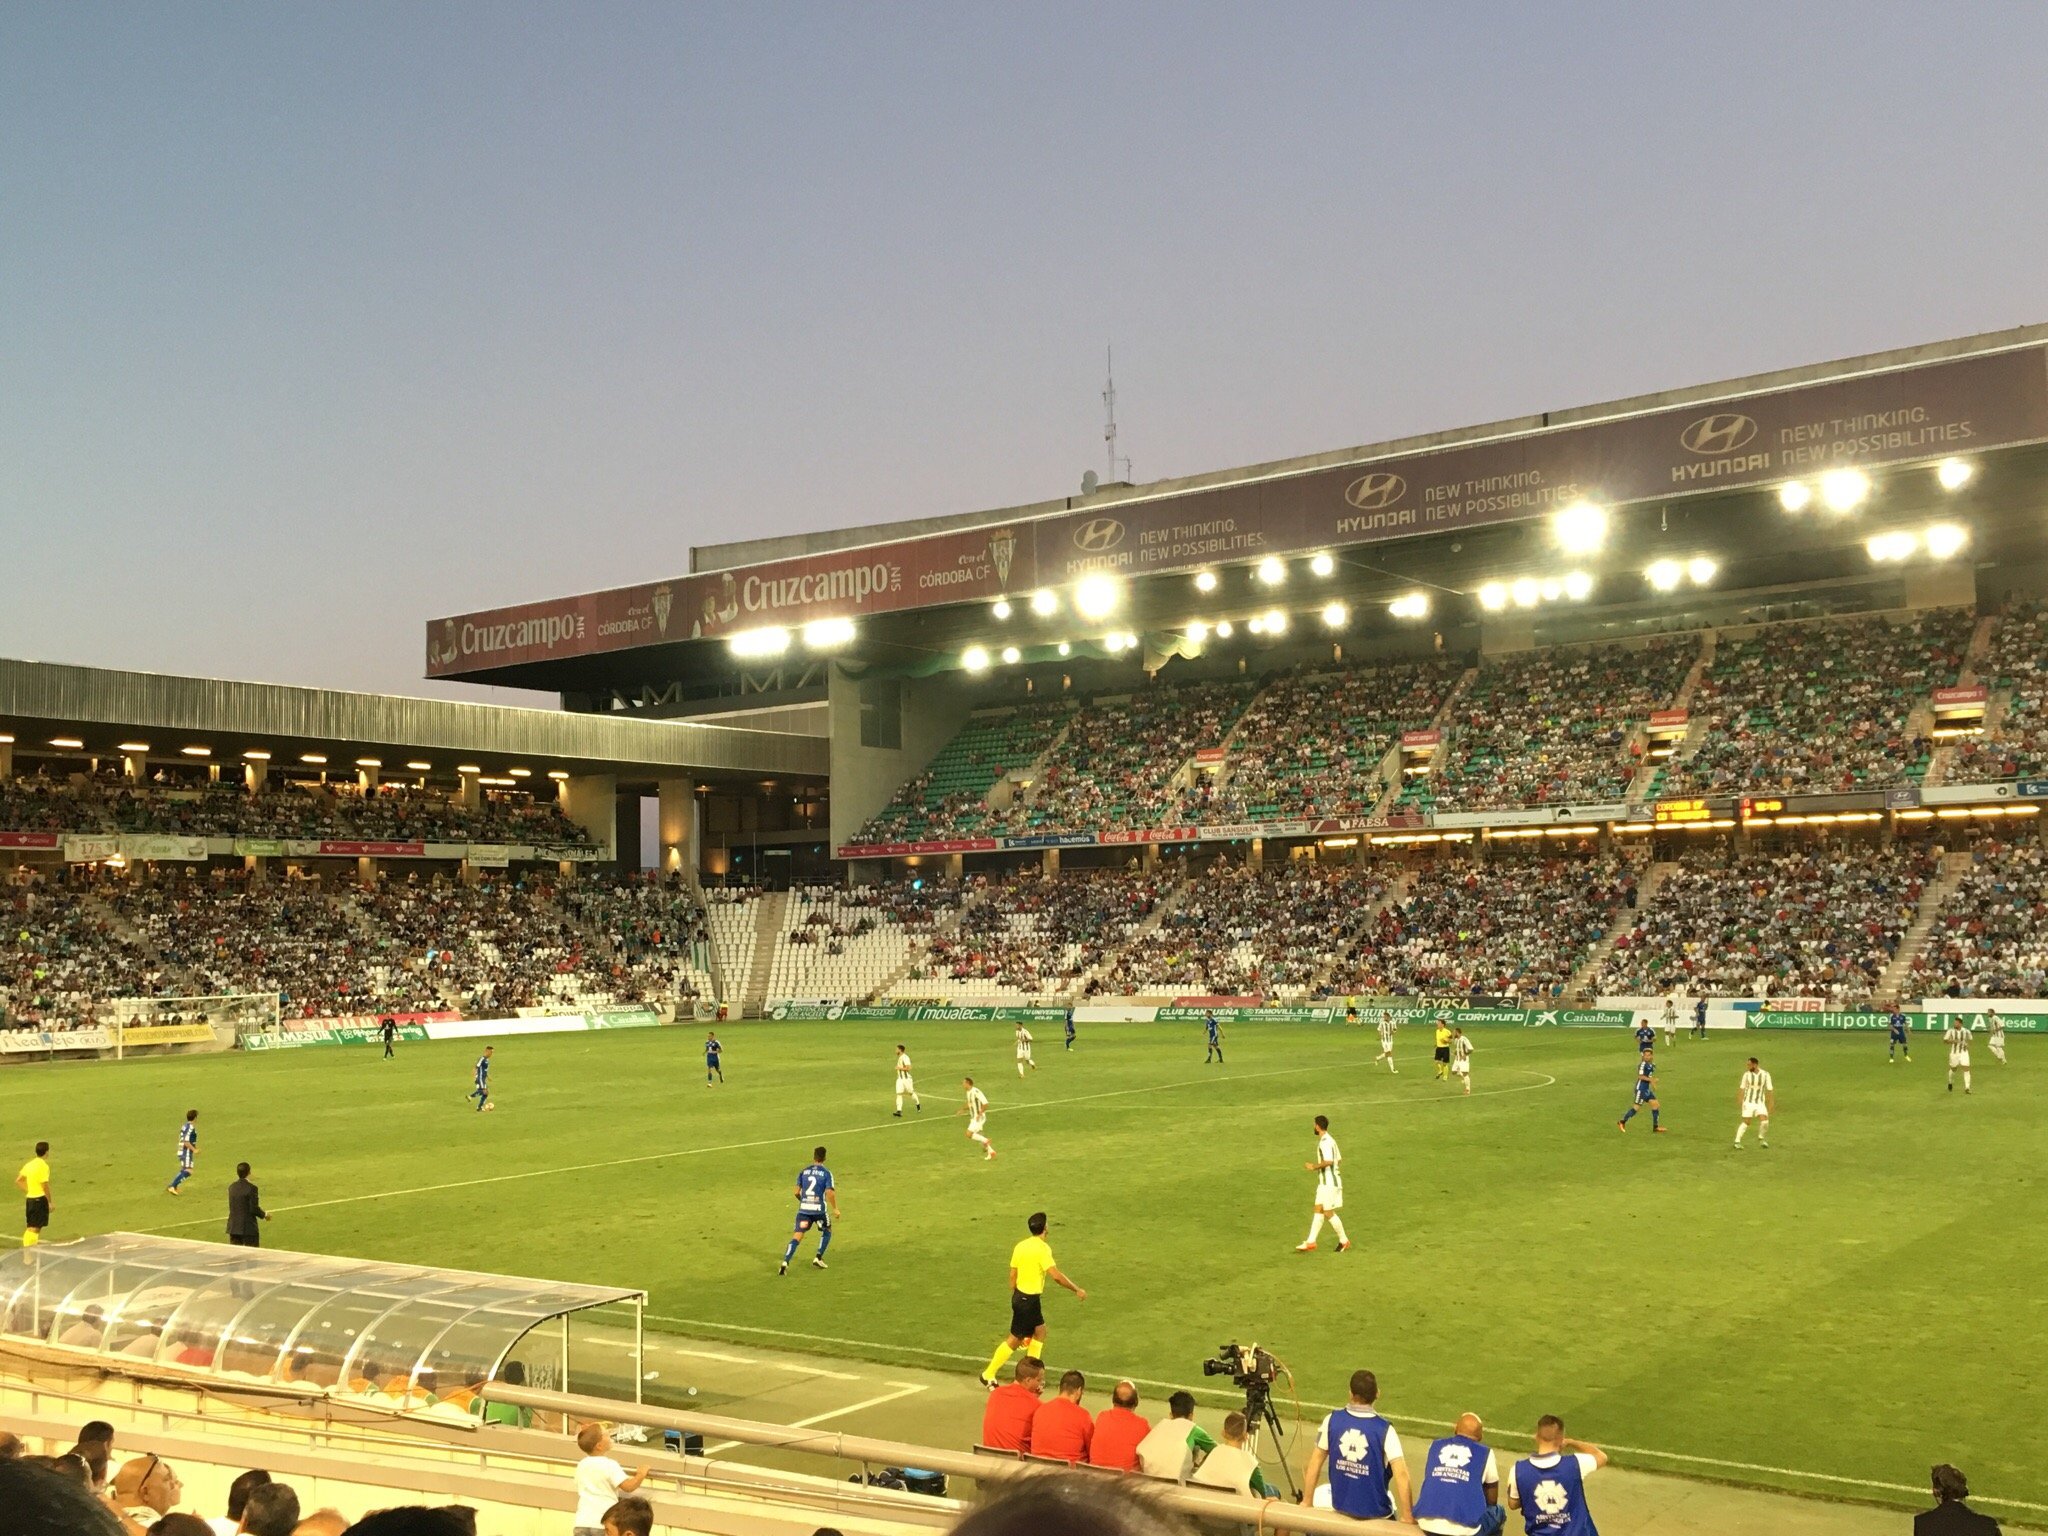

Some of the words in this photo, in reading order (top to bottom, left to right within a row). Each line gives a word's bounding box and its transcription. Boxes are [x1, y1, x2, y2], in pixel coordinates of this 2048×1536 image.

[1781, 422, 1825, 444] NEW
[1830, 406, 1930, 436] THINKING.
[1781, 444, 1827, 466] NEW
[1671, 453, 1770, 482] HYUNDAI
[1425, 482, 1460, 502] NEW
[1465, 470, 1545, 496] THINKING.
[1337, 509, 1416, 534] HYUNDAI
[1425, 502, 1461, 521] NEW
[1140, 528, 1169, 545] NEW
[1066, 551, 1133, 574] HYUNDAI
[1140, 545, 1169, 562] NEW
[890, 566, 902, 592] SIN
[919, 569, 974, 589] CÓRDOBA
[975, 565, 991, 580] CF
[743, 563, 888, 612] Cruzcampo
[461, 613, 574, 655] Cruzcampo
[576, 616, 585, 639] SIN
[597, 619, 639, 637] CÓRDOBA
[641, 616, 654, 631] CF
[1351, 817, 1390, 829] FAESA
[607, 1004, 645, 1013] Kappa
[860, 1007, 896, 1017] Kappa
[890, 998, 941, 1007] JUNKERS
[1186, 1006, 1239, 1016] SANUEÑA
[1769, 1001, 1822, 1012] SEUR
[1457, 1013, 1525, 1022] CORHYUND
[1562, 1011, 1625, 1023] CaixaBank
[1767, 1013, 1816, 1027] CajaSur
[1822, 1013, 1913, 1030] Hipotea
[1926, 1013, 1987, 1031] FIA
[265, 1030, 334, 1042] TAMESUR
[805, 1175, 817, 1196] 2
